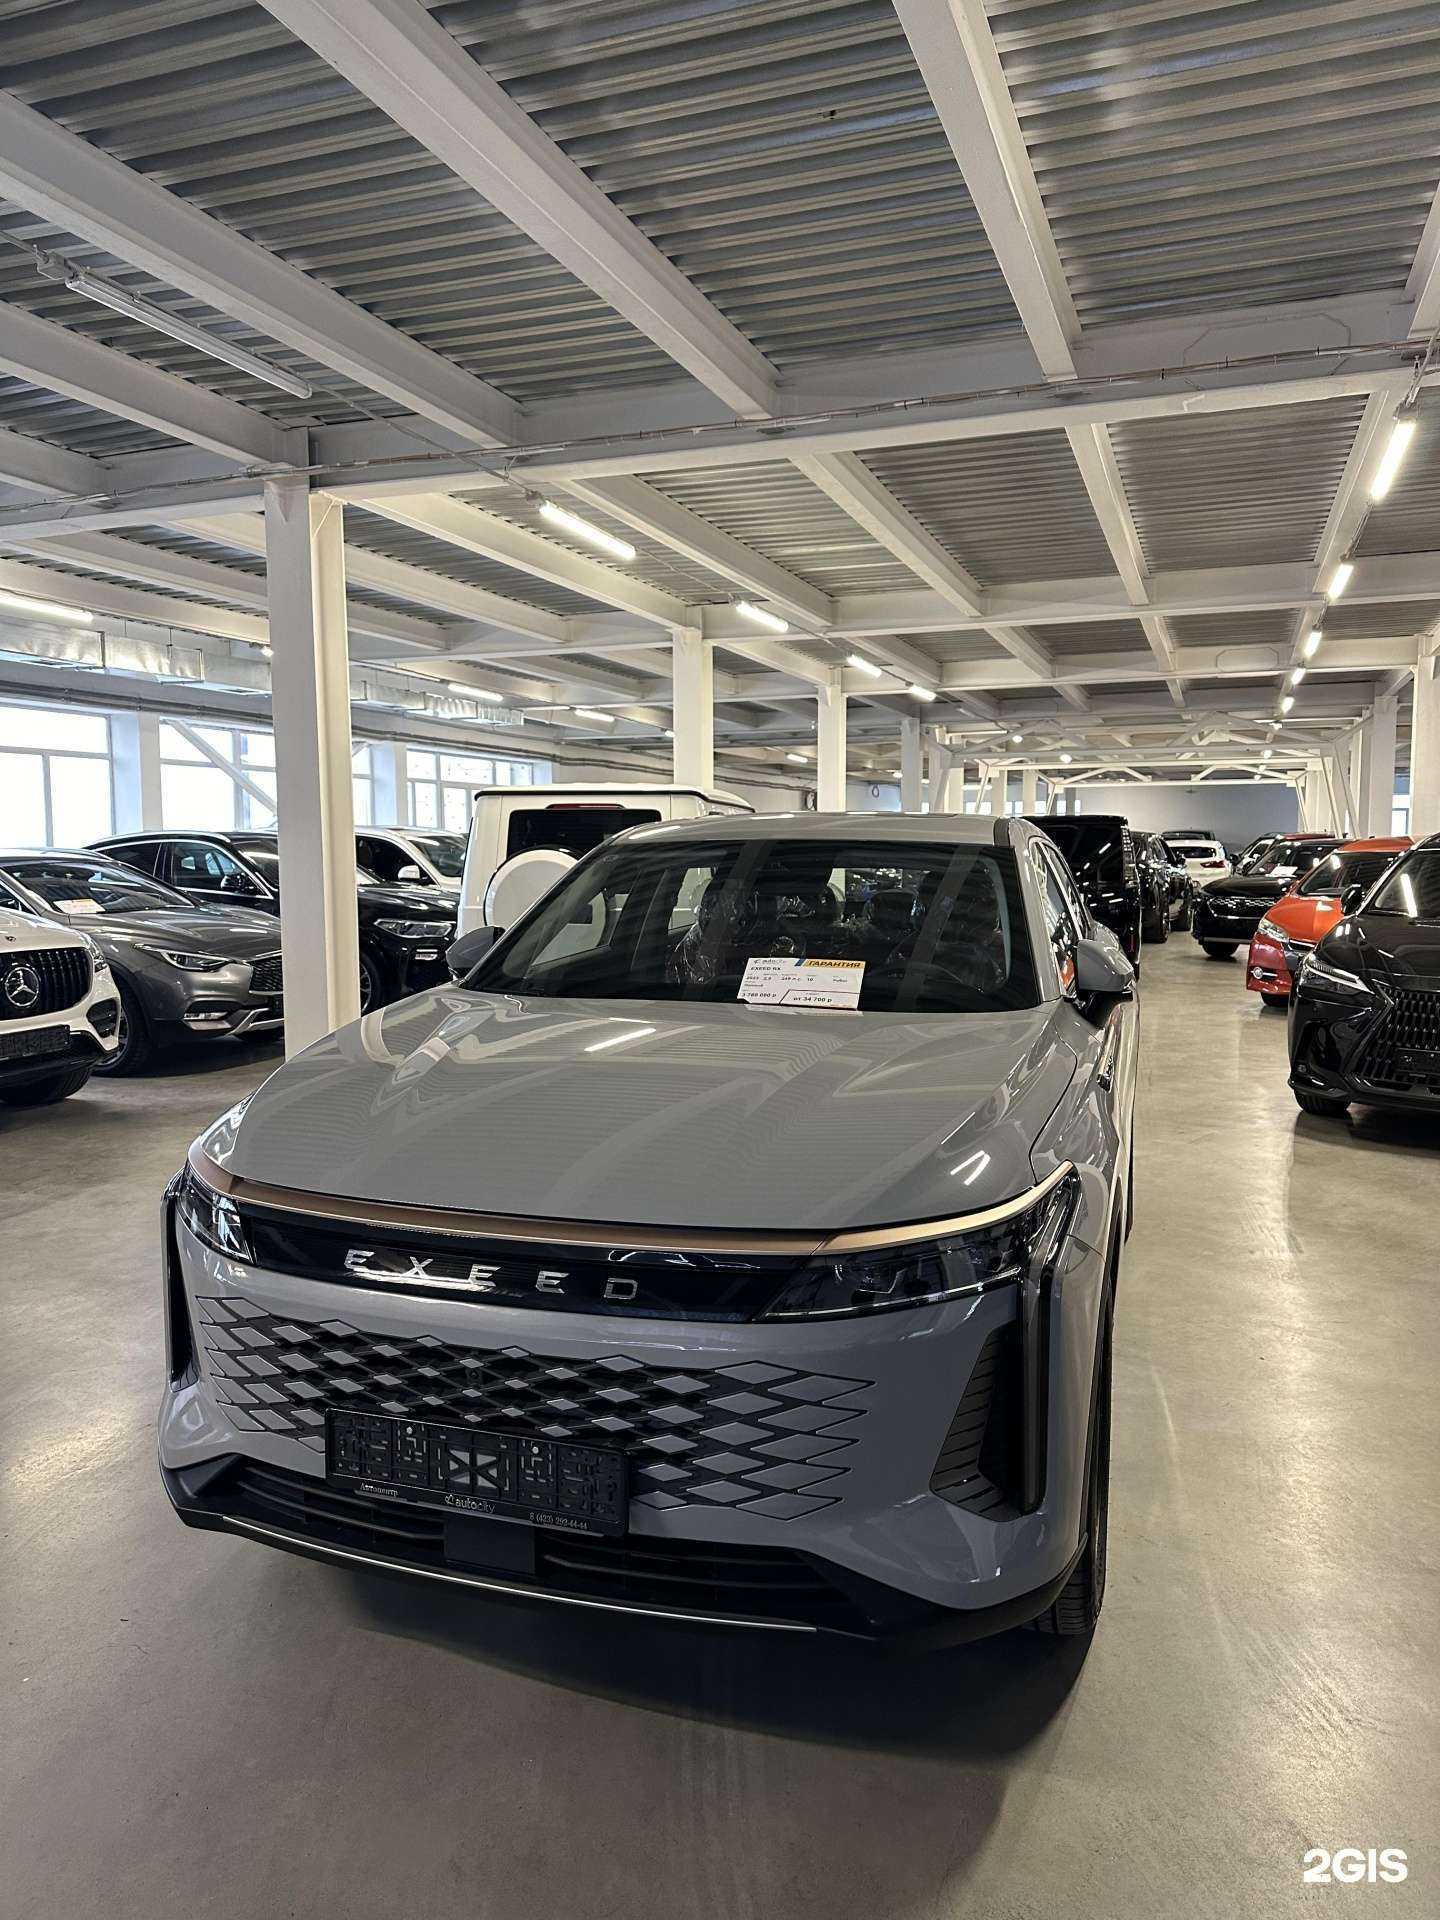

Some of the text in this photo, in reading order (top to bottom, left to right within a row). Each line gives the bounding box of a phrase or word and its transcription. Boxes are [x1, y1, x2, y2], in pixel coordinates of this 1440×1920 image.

[808, 960, 860, 968] ГАРАНТИЯ
[344, 1248, 639, 1301] EXEED
[455, 1495, 496, 1514] autocity
